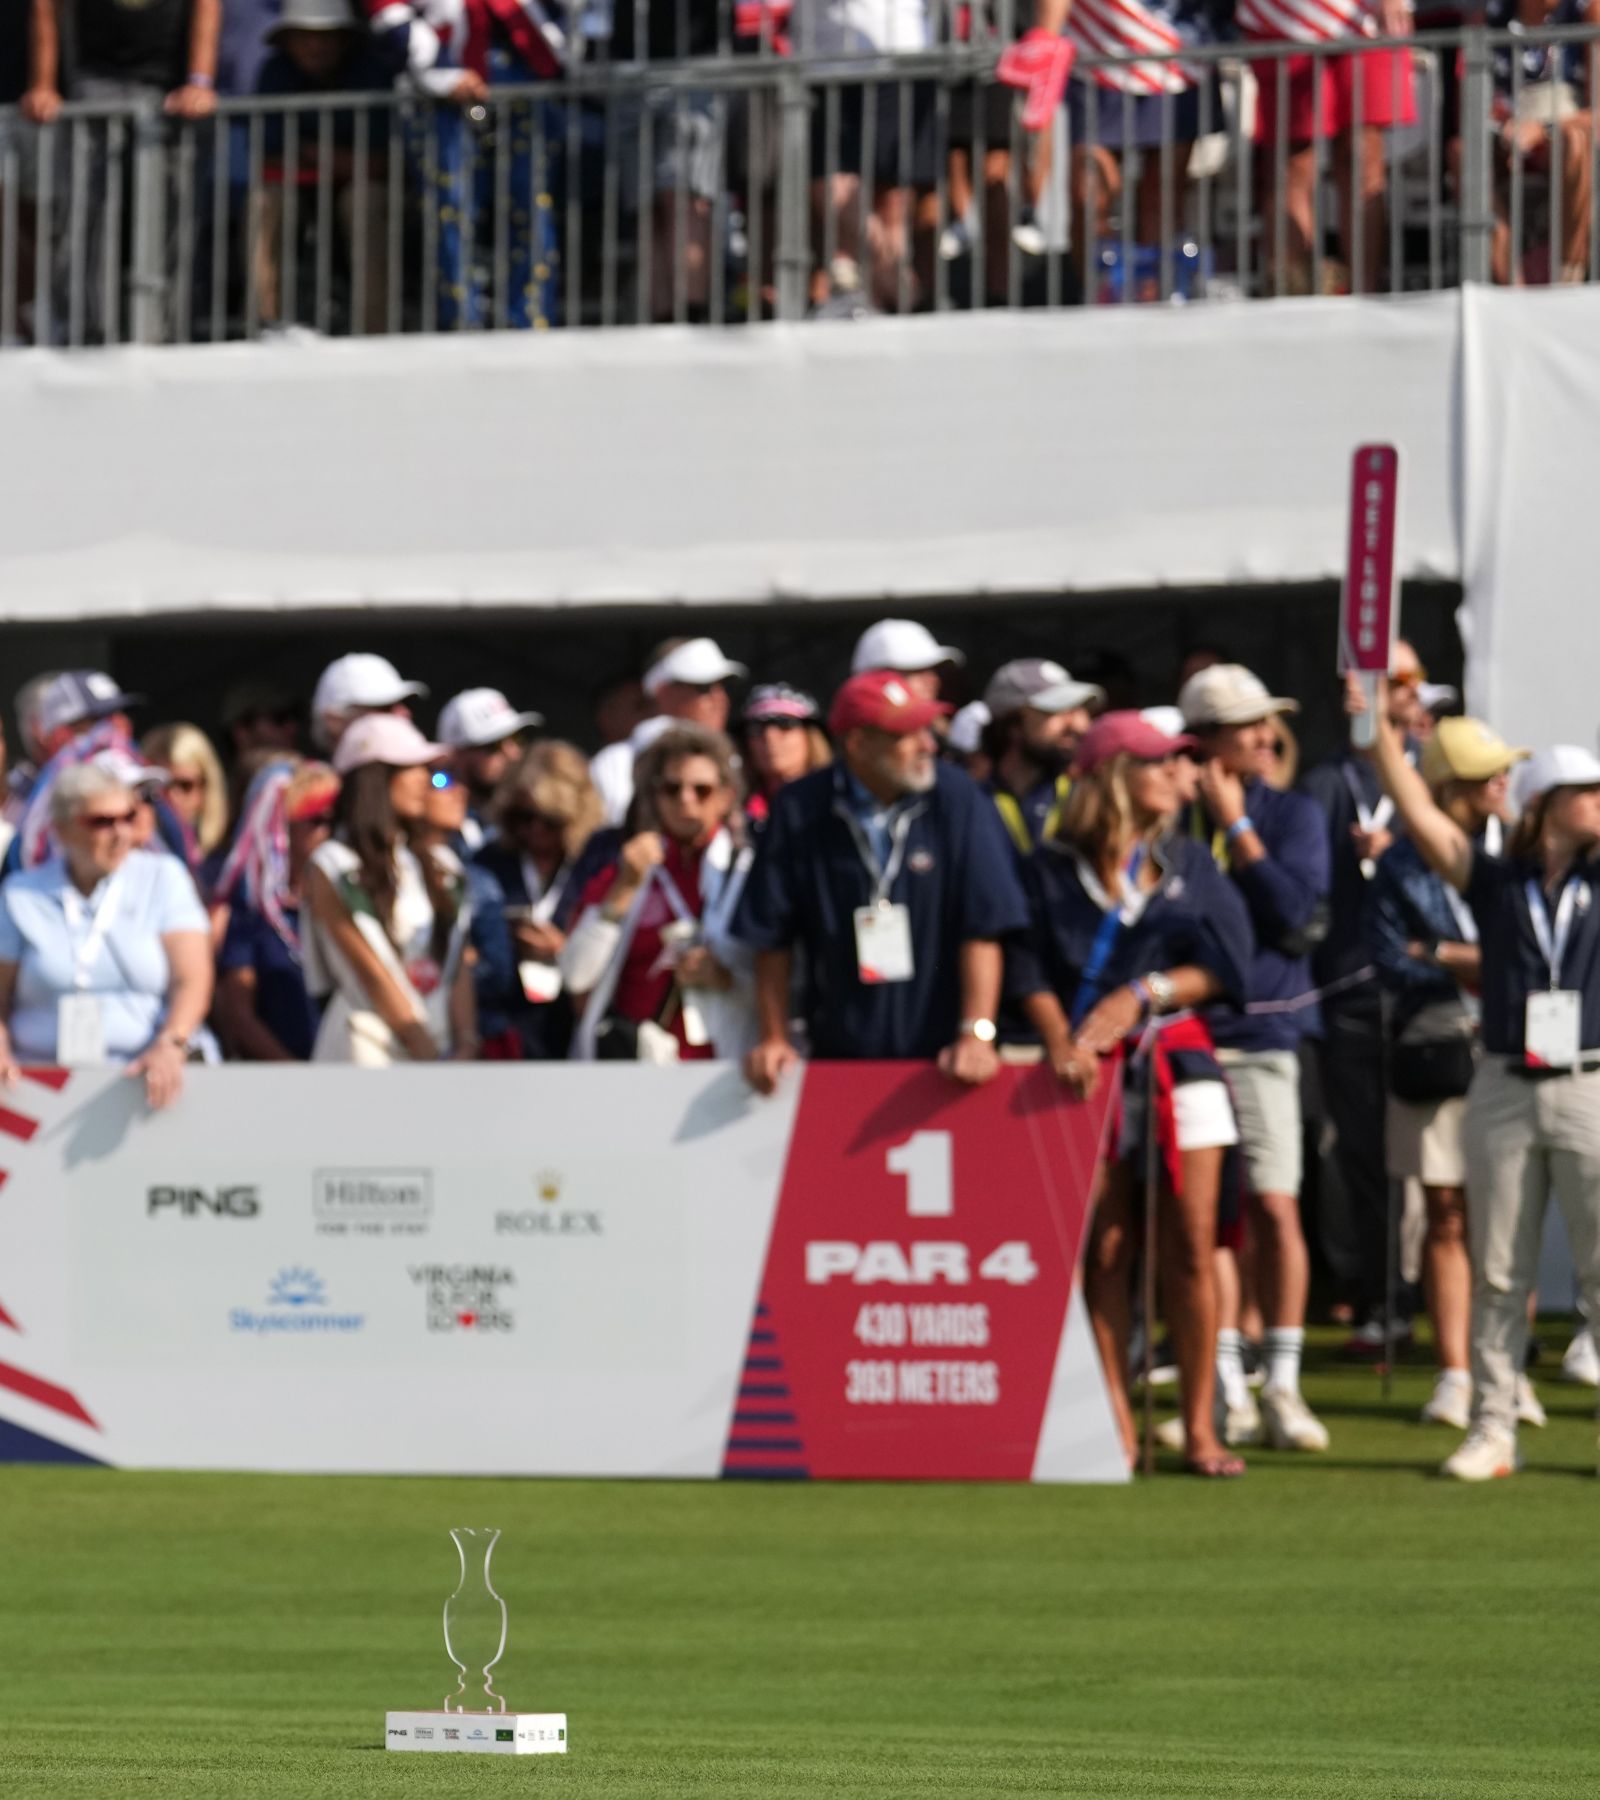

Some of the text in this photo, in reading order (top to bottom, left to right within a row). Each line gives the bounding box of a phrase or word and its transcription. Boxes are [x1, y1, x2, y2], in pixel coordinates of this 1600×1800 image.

[324, 1179, 422, 1205] Hilton
[885, 1129, 954, 1217] 1
[146, 1184, 261, 1219] PING
[495, 1211, 601, 1235] ROLEX
[805, 1241, 1039, 1285] PAR 4
[230, 1309, 364, 1333] Skyscanner
[853, 1302, 990, 1346] 430 YARDS
[898, 1359, 1000, 1405] METERS
